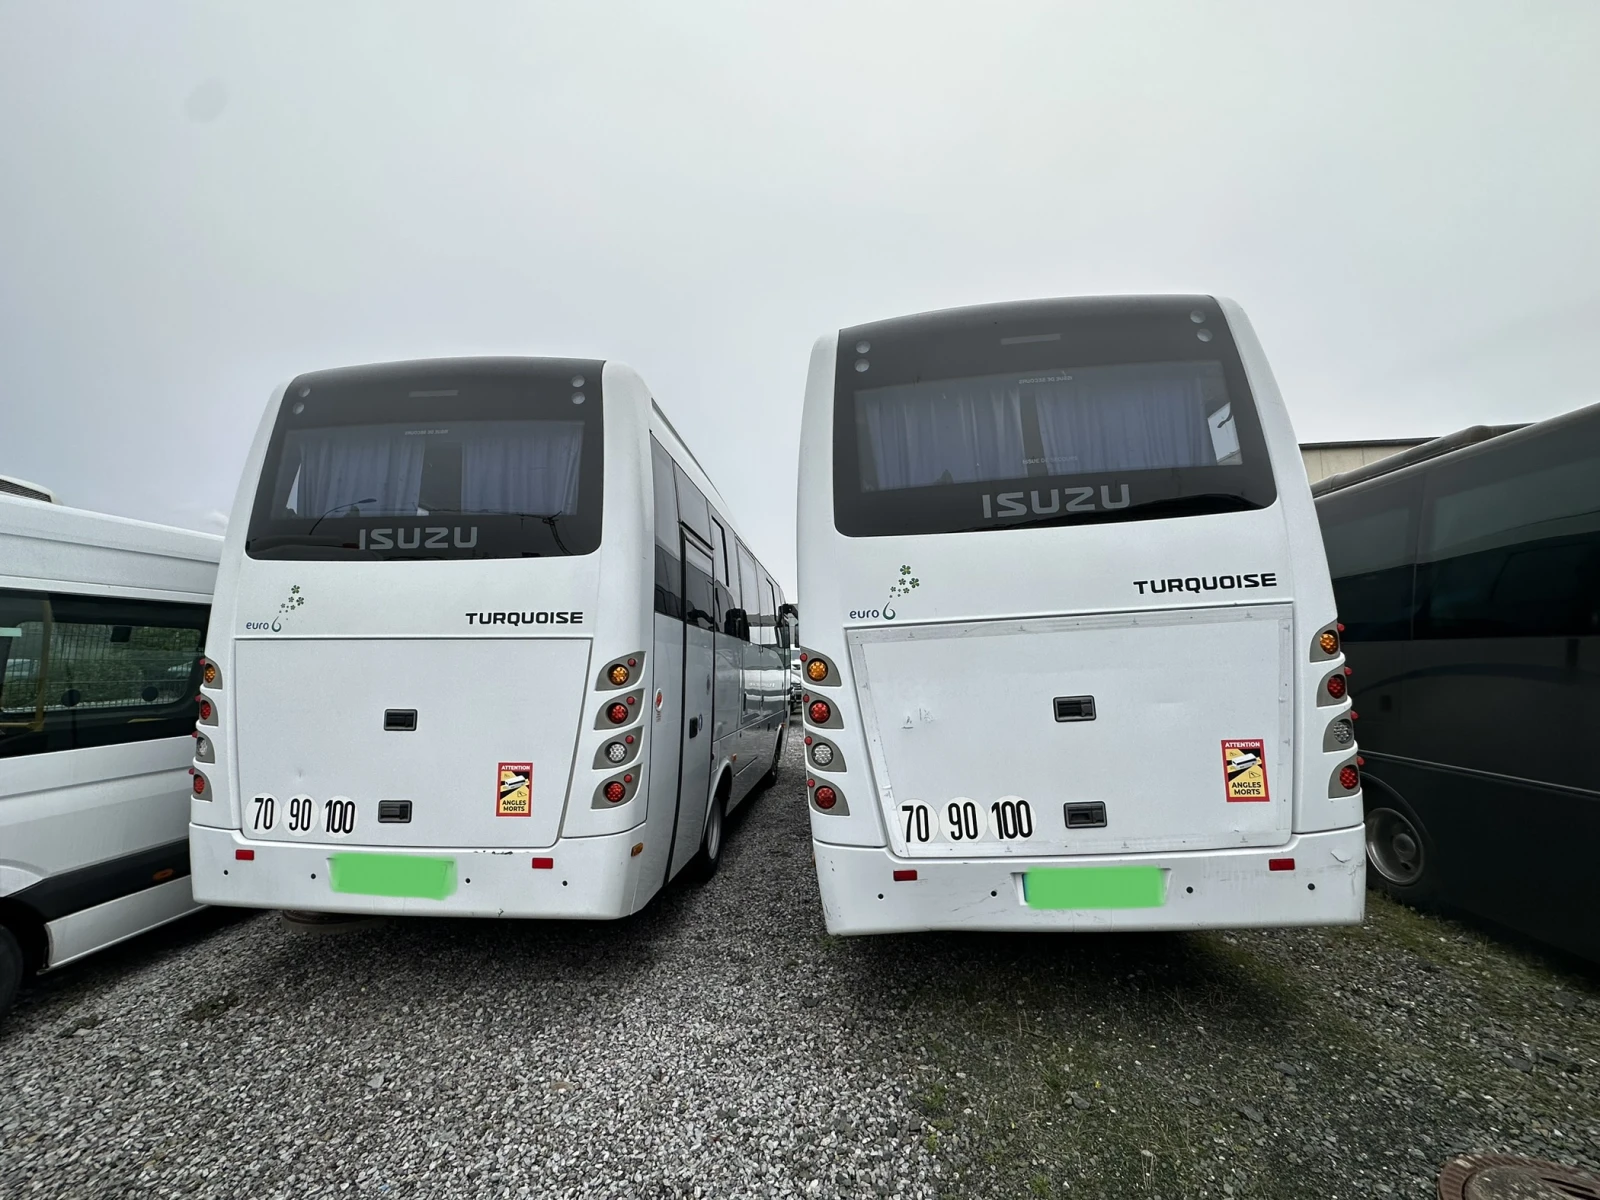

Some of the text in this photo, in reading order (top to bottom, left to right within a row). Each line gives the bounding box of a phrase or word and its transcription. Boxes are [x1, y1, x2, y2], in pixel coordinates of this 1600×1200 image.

[981, 483, 1131, 519] ISUZU
[359, 526, 478, 550] ISUZU
[1132, 572, 1277, 595] TURQUOISE
[465, 611, 584, 627] TURQUOISE
[849, 609, 880, 619] euro
[245, 621, 270, 630] euro
[1231, 781, 1262, 789] ANGLES
[1233, 788, 1261, 796] MORTS
[253, 797, 356, 835] 70 90 100
[901, 799, 1033, 843] 70 90 100
